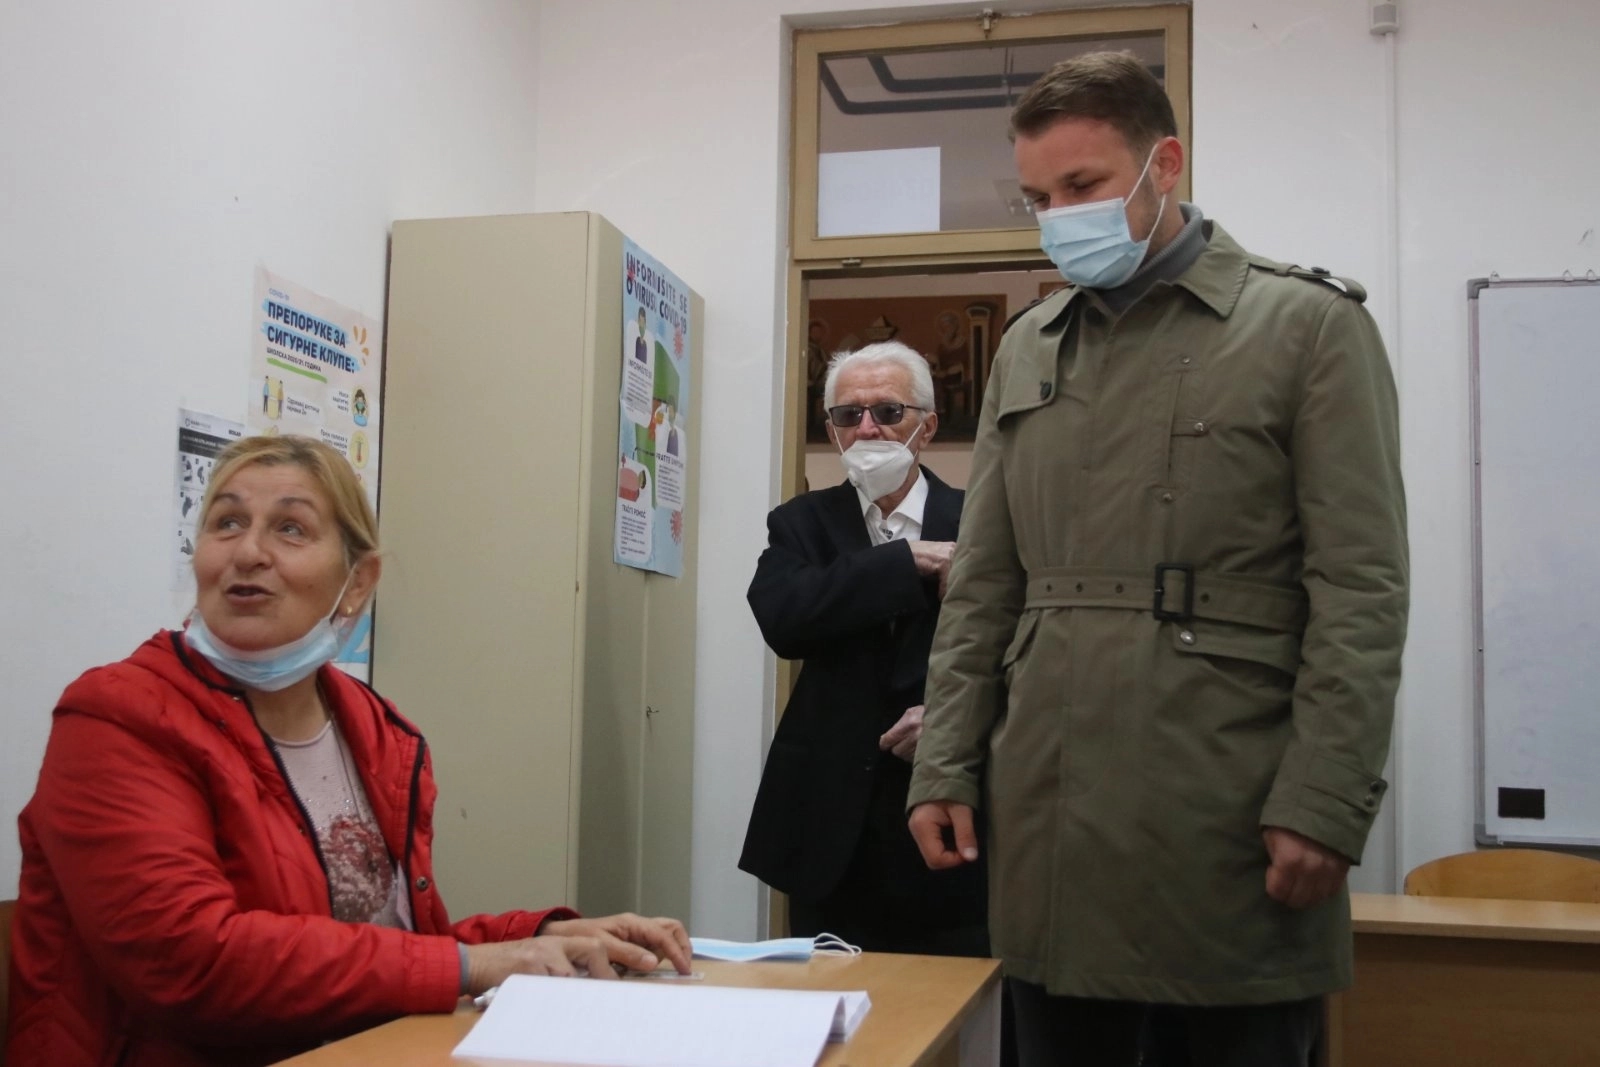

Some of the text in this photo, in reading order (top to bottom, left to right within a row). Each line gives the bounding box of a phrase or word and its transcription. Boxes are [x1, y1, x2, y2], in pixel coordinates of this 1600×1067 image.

[626, 276, 633, 296] O
[679, 292, 688, 314] SE
[267, 301, 346, 349] ПРЕПОРУКЕ ЗА
[267, 325, 355, 374] СИГУРНЕ КЛУПЕ:
